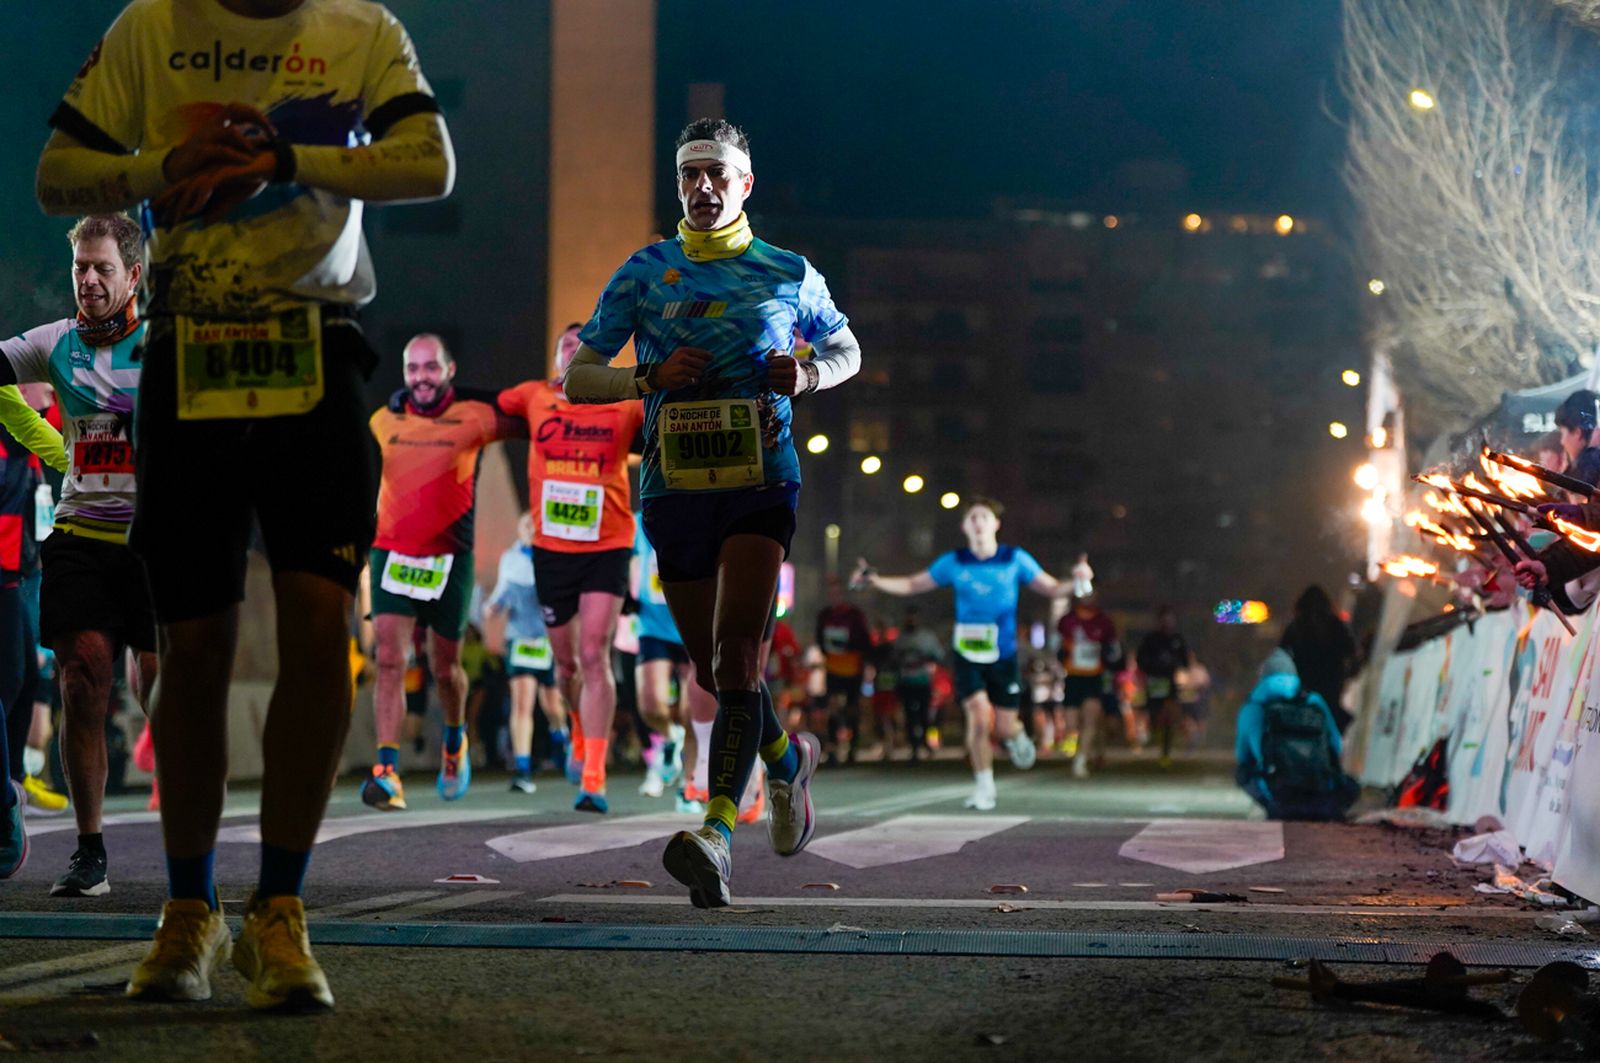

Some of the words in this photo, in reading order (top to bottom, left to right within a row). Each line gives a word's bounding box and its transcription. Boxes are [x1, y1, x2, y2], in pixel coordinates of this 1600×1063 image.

[168, 40, 326, 82] calderón
[206, 341, 298, 379] 8404
[680, 411, 708, 420] NOCHE
[710, 410, 721, 419] DE
[670, 422, 689, 433] SAN
[690, 418, 722, 432] ANTÓN
[678, 431, 743, 459] 9002
[546, 459, 600, 478] BRILLA
[552, 502, 589, 522] 4425
